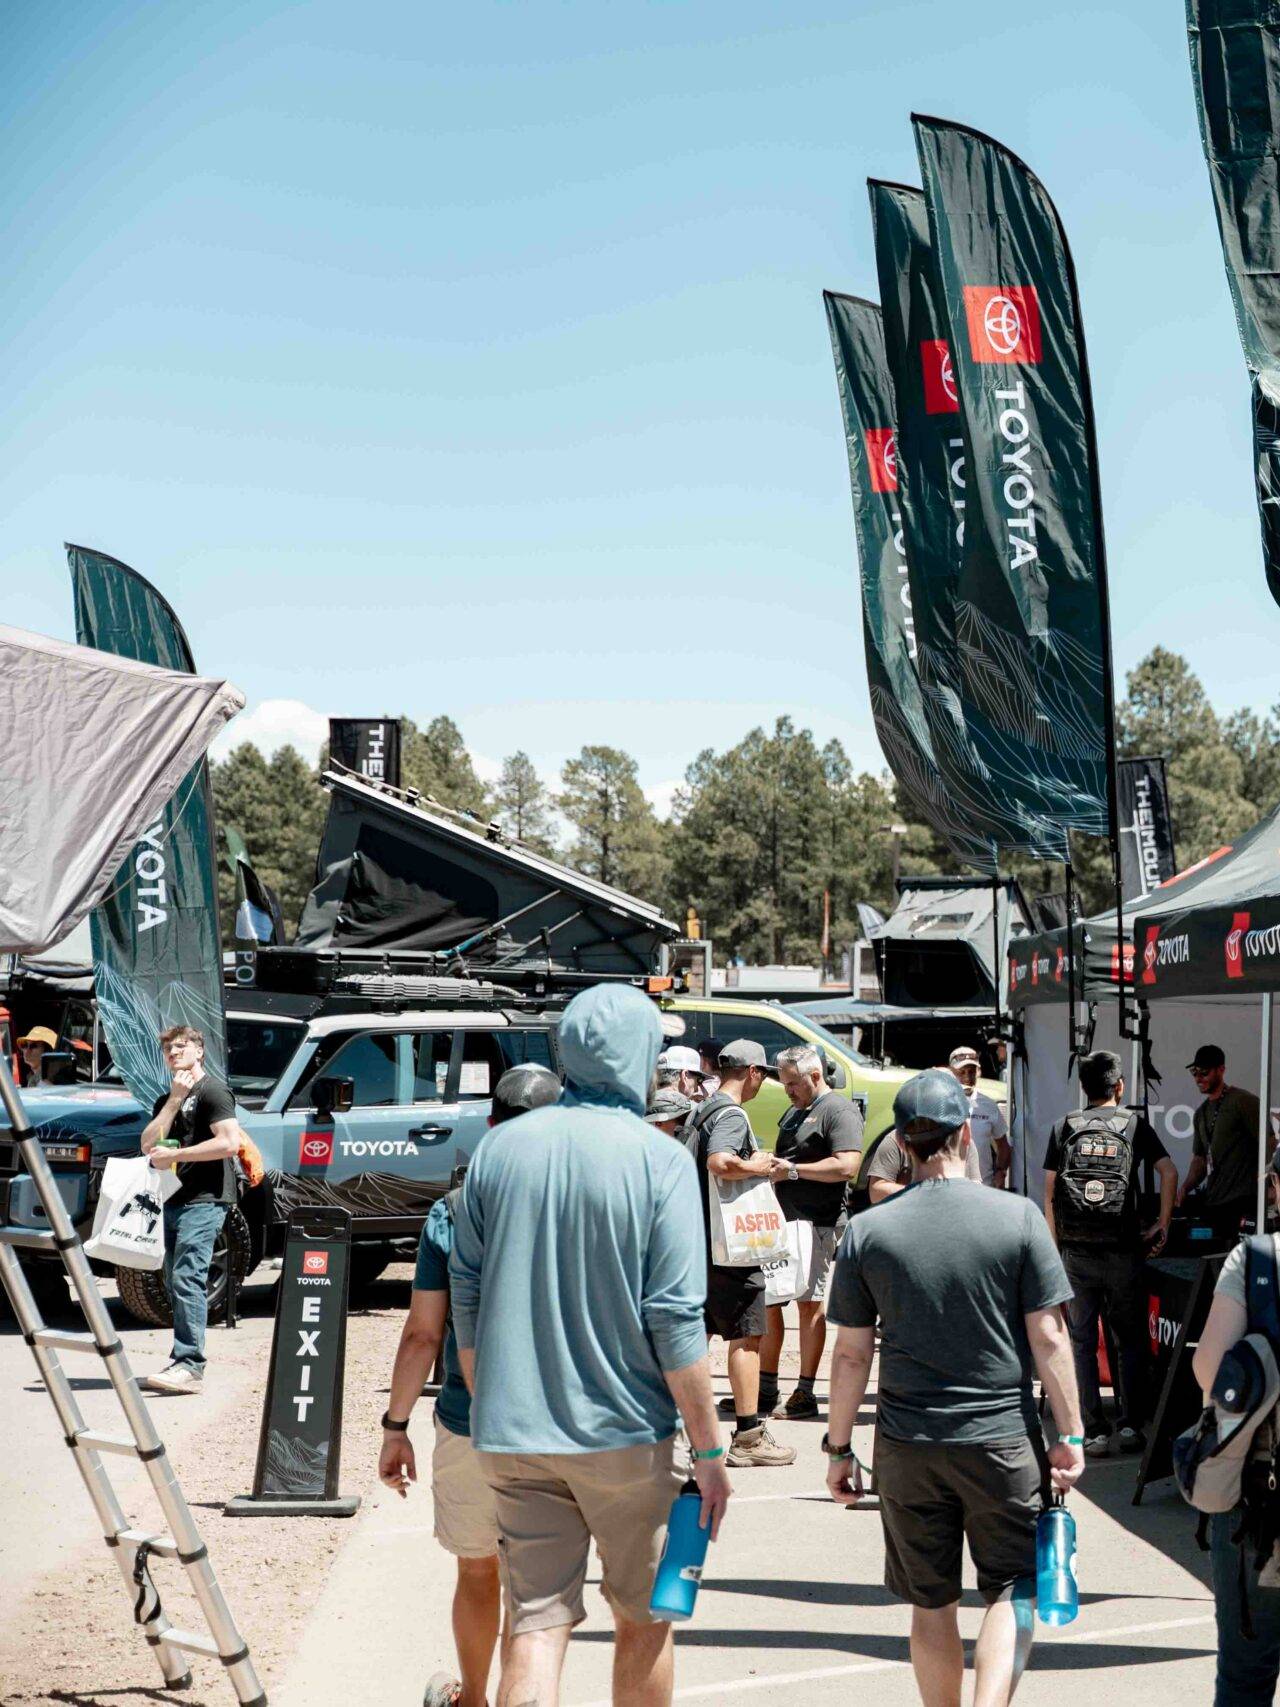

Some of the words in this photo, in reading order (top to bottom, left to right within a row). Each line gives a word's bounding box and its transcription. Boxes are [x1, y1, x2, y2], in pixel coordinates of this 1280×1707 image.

[994, 380, 1038, 571] TOYOTA
[1156, 933, 1190, 967] TOYOTA
[339, 1140, 420, 1157] TOYOTA
[734, 1212, 781, 1234] ASFIR
[296, 1276, 332, 1286] TOYOTA
[292, 1296, 322, 1423] EXIT
